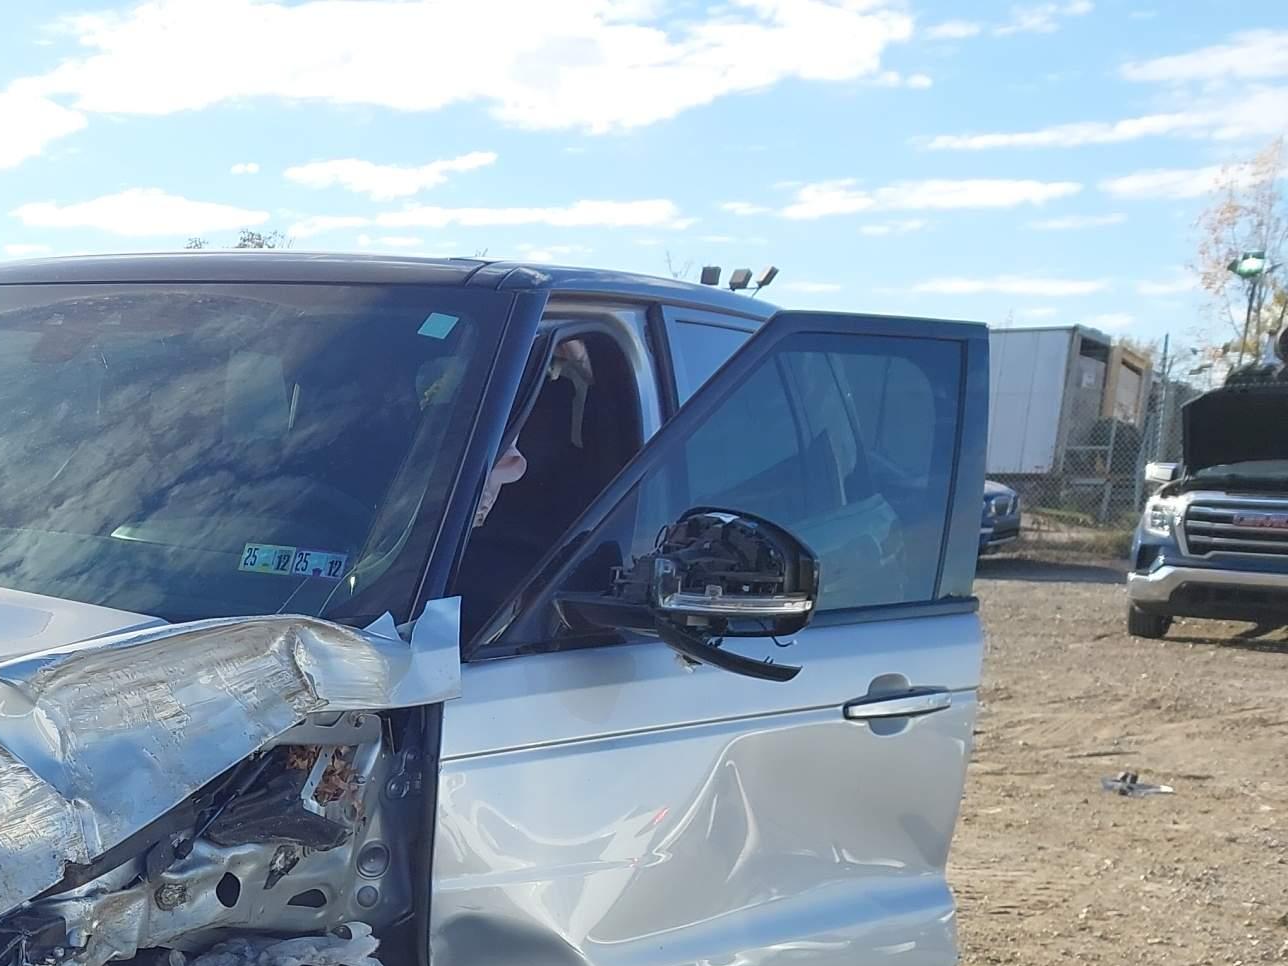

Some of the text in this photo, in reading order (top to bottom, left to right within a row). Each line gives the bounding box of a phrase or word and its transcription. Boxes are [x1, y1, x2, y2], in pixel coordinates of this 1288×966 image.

[243, 547, 291, 571] 25 12
[294, 552, 343, 577] 25 12
